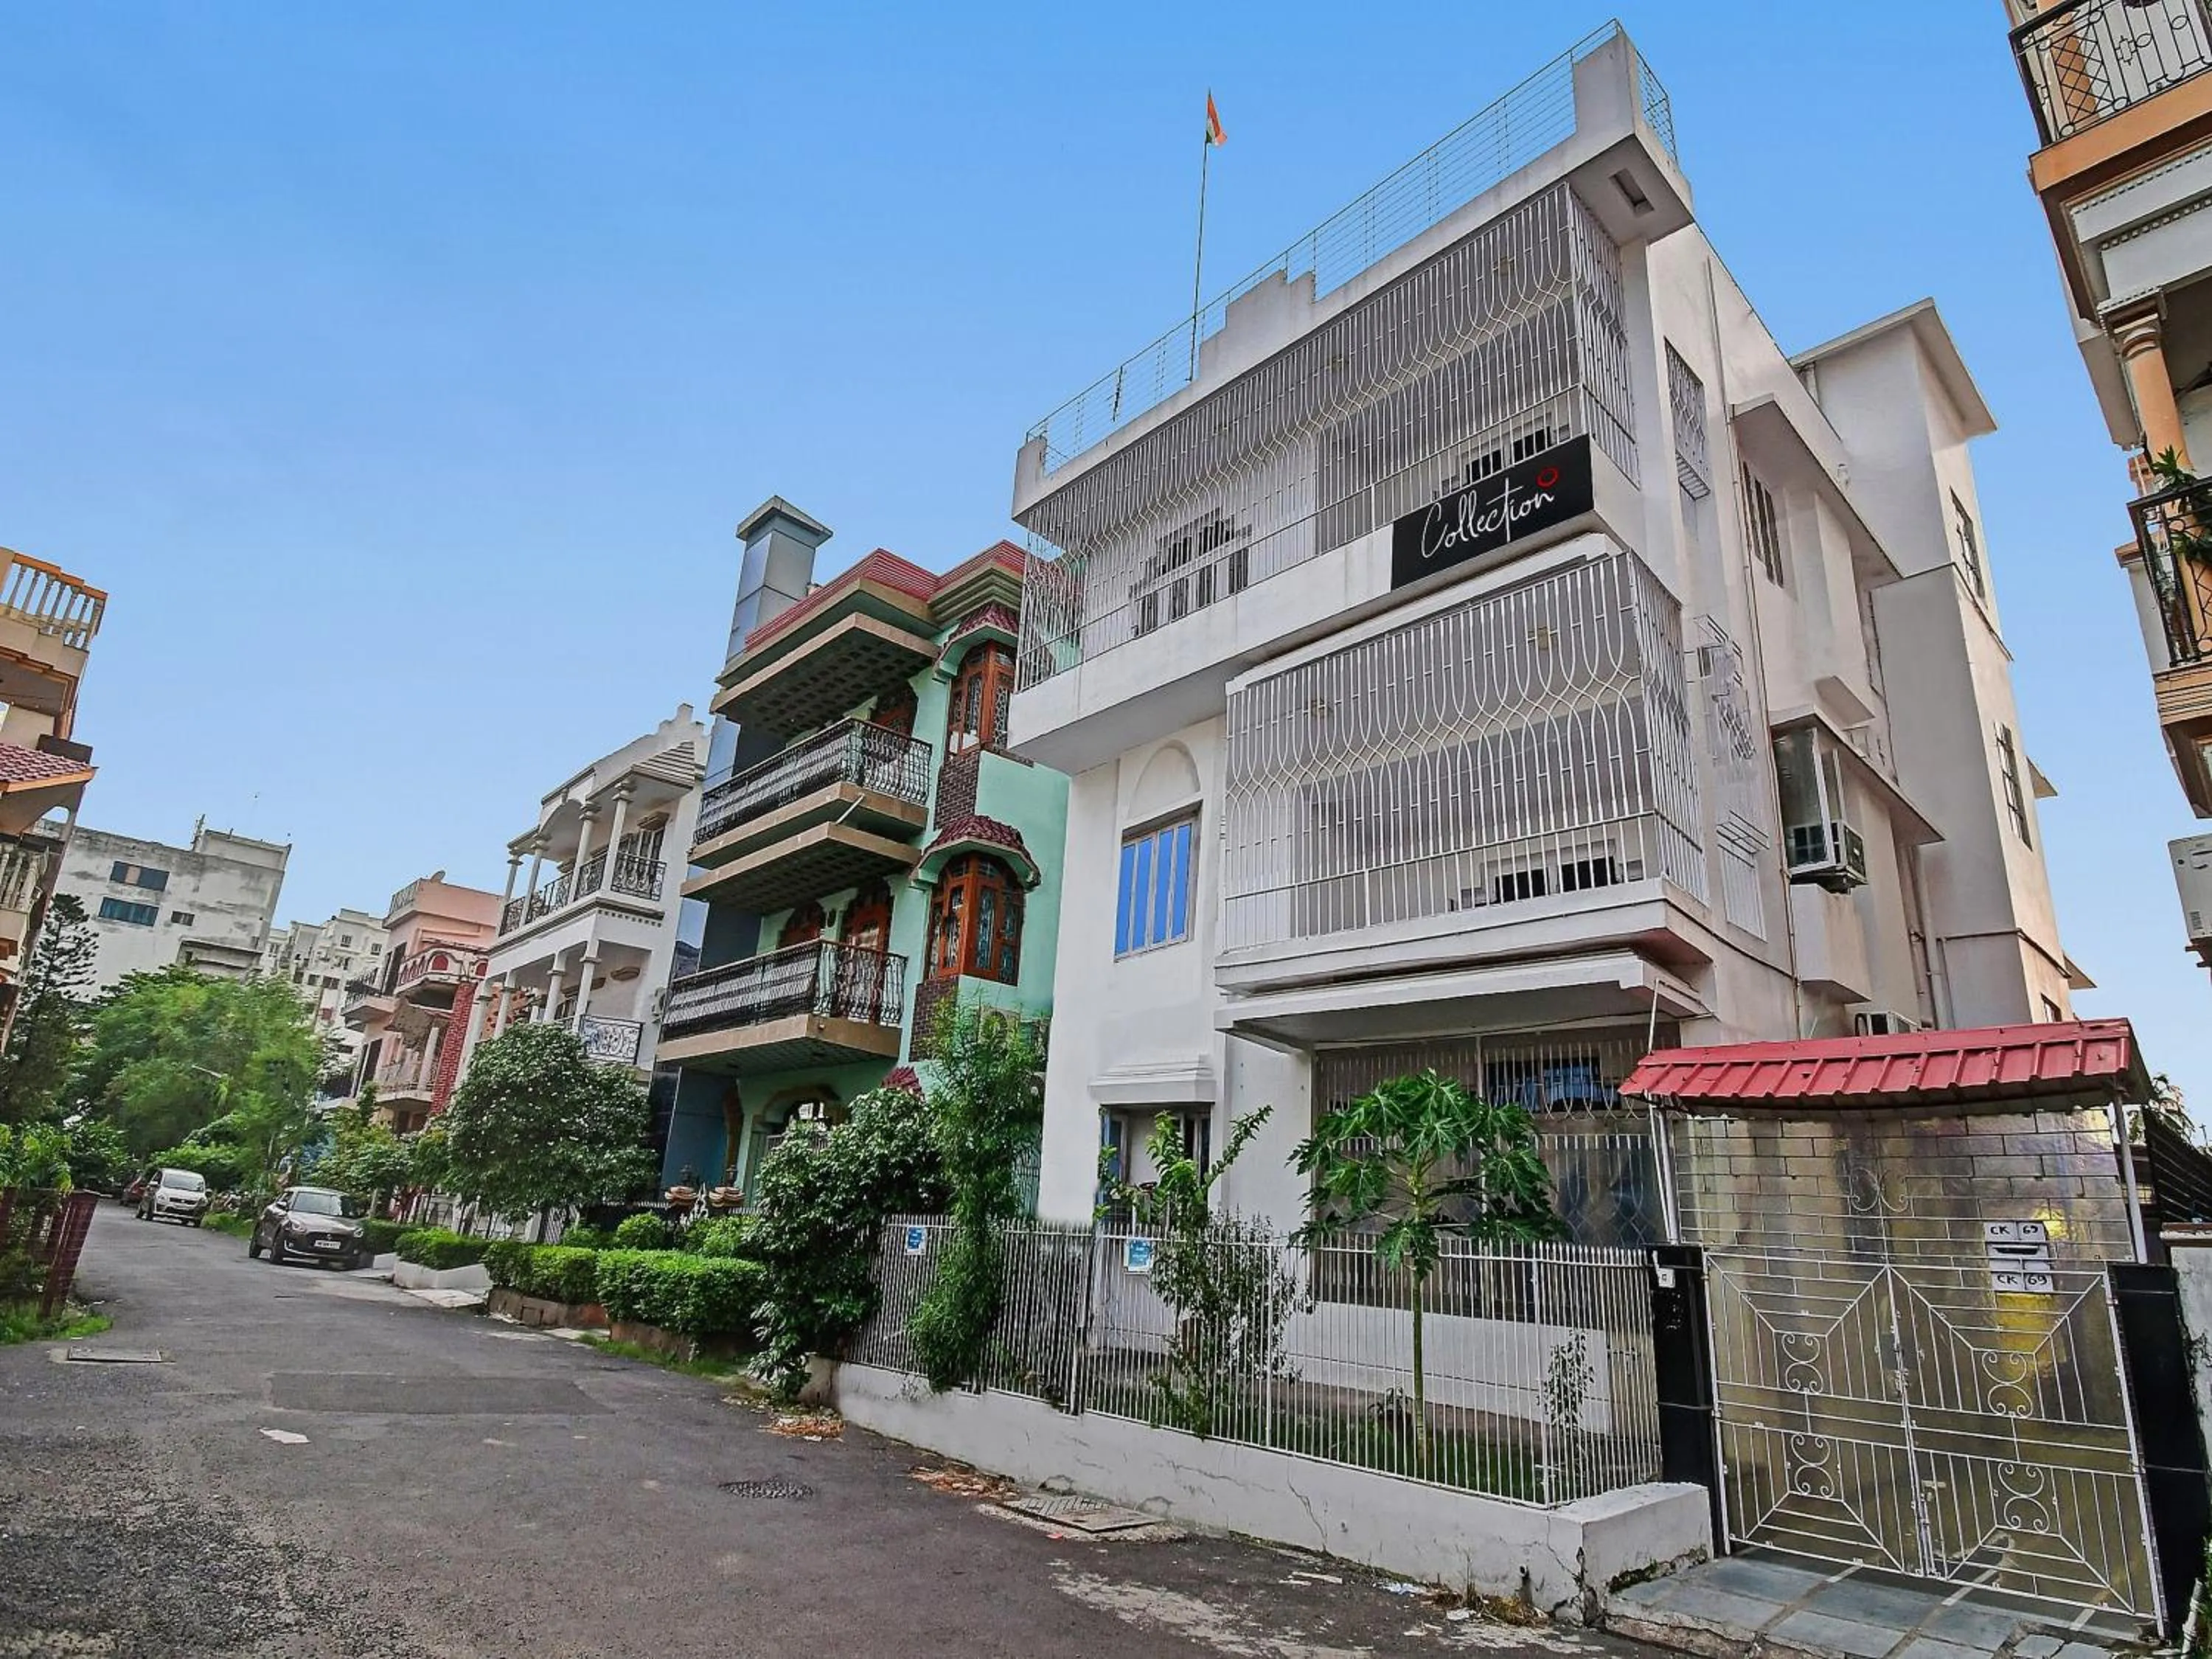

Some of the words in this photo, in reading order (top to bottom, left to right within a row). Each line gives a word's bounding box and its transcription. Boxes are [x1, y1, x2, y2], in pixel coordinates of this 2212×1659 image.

[1420, 477, 1555, 559] Collection
[1990, 1225, 2011, 1235] CK
[1997, 1274, 2018, 1284] CK
[2028, 1274, 2048, 1285] 69
